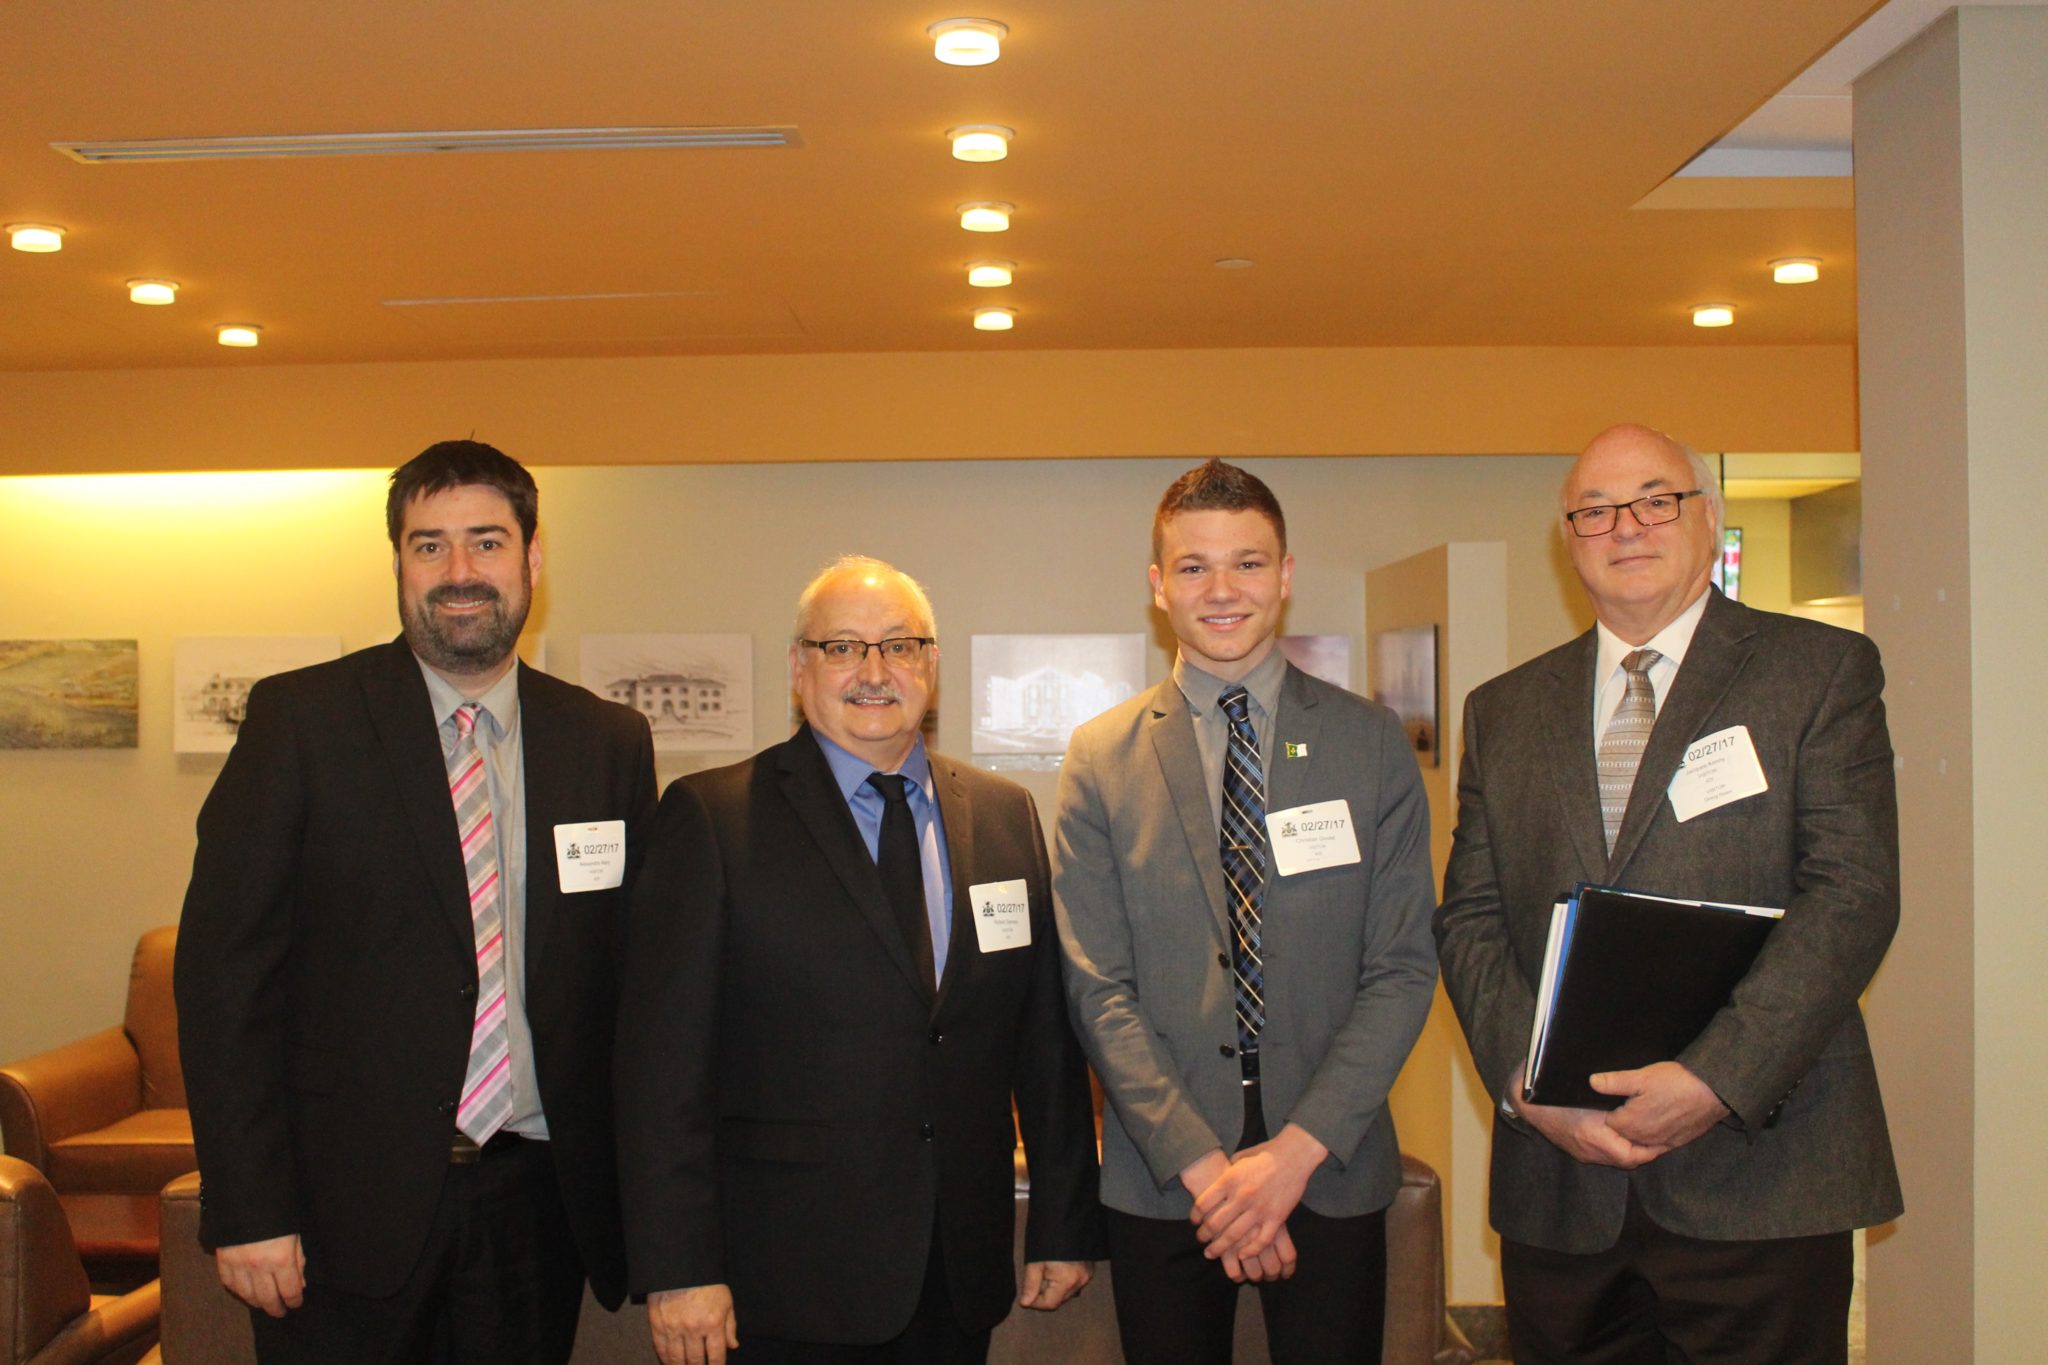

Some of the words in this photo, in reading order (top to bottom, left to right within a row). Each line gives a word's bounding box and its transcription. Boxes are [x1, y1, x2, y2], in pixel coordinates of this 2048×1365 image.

[1688, 736, 1735, 762] 02/27/17
[1301, 819, 1345, 832] 02/27/17
[583, 843, 619, 855] 02/27/17
[996, 903, 1025, 913] 02/27/17
